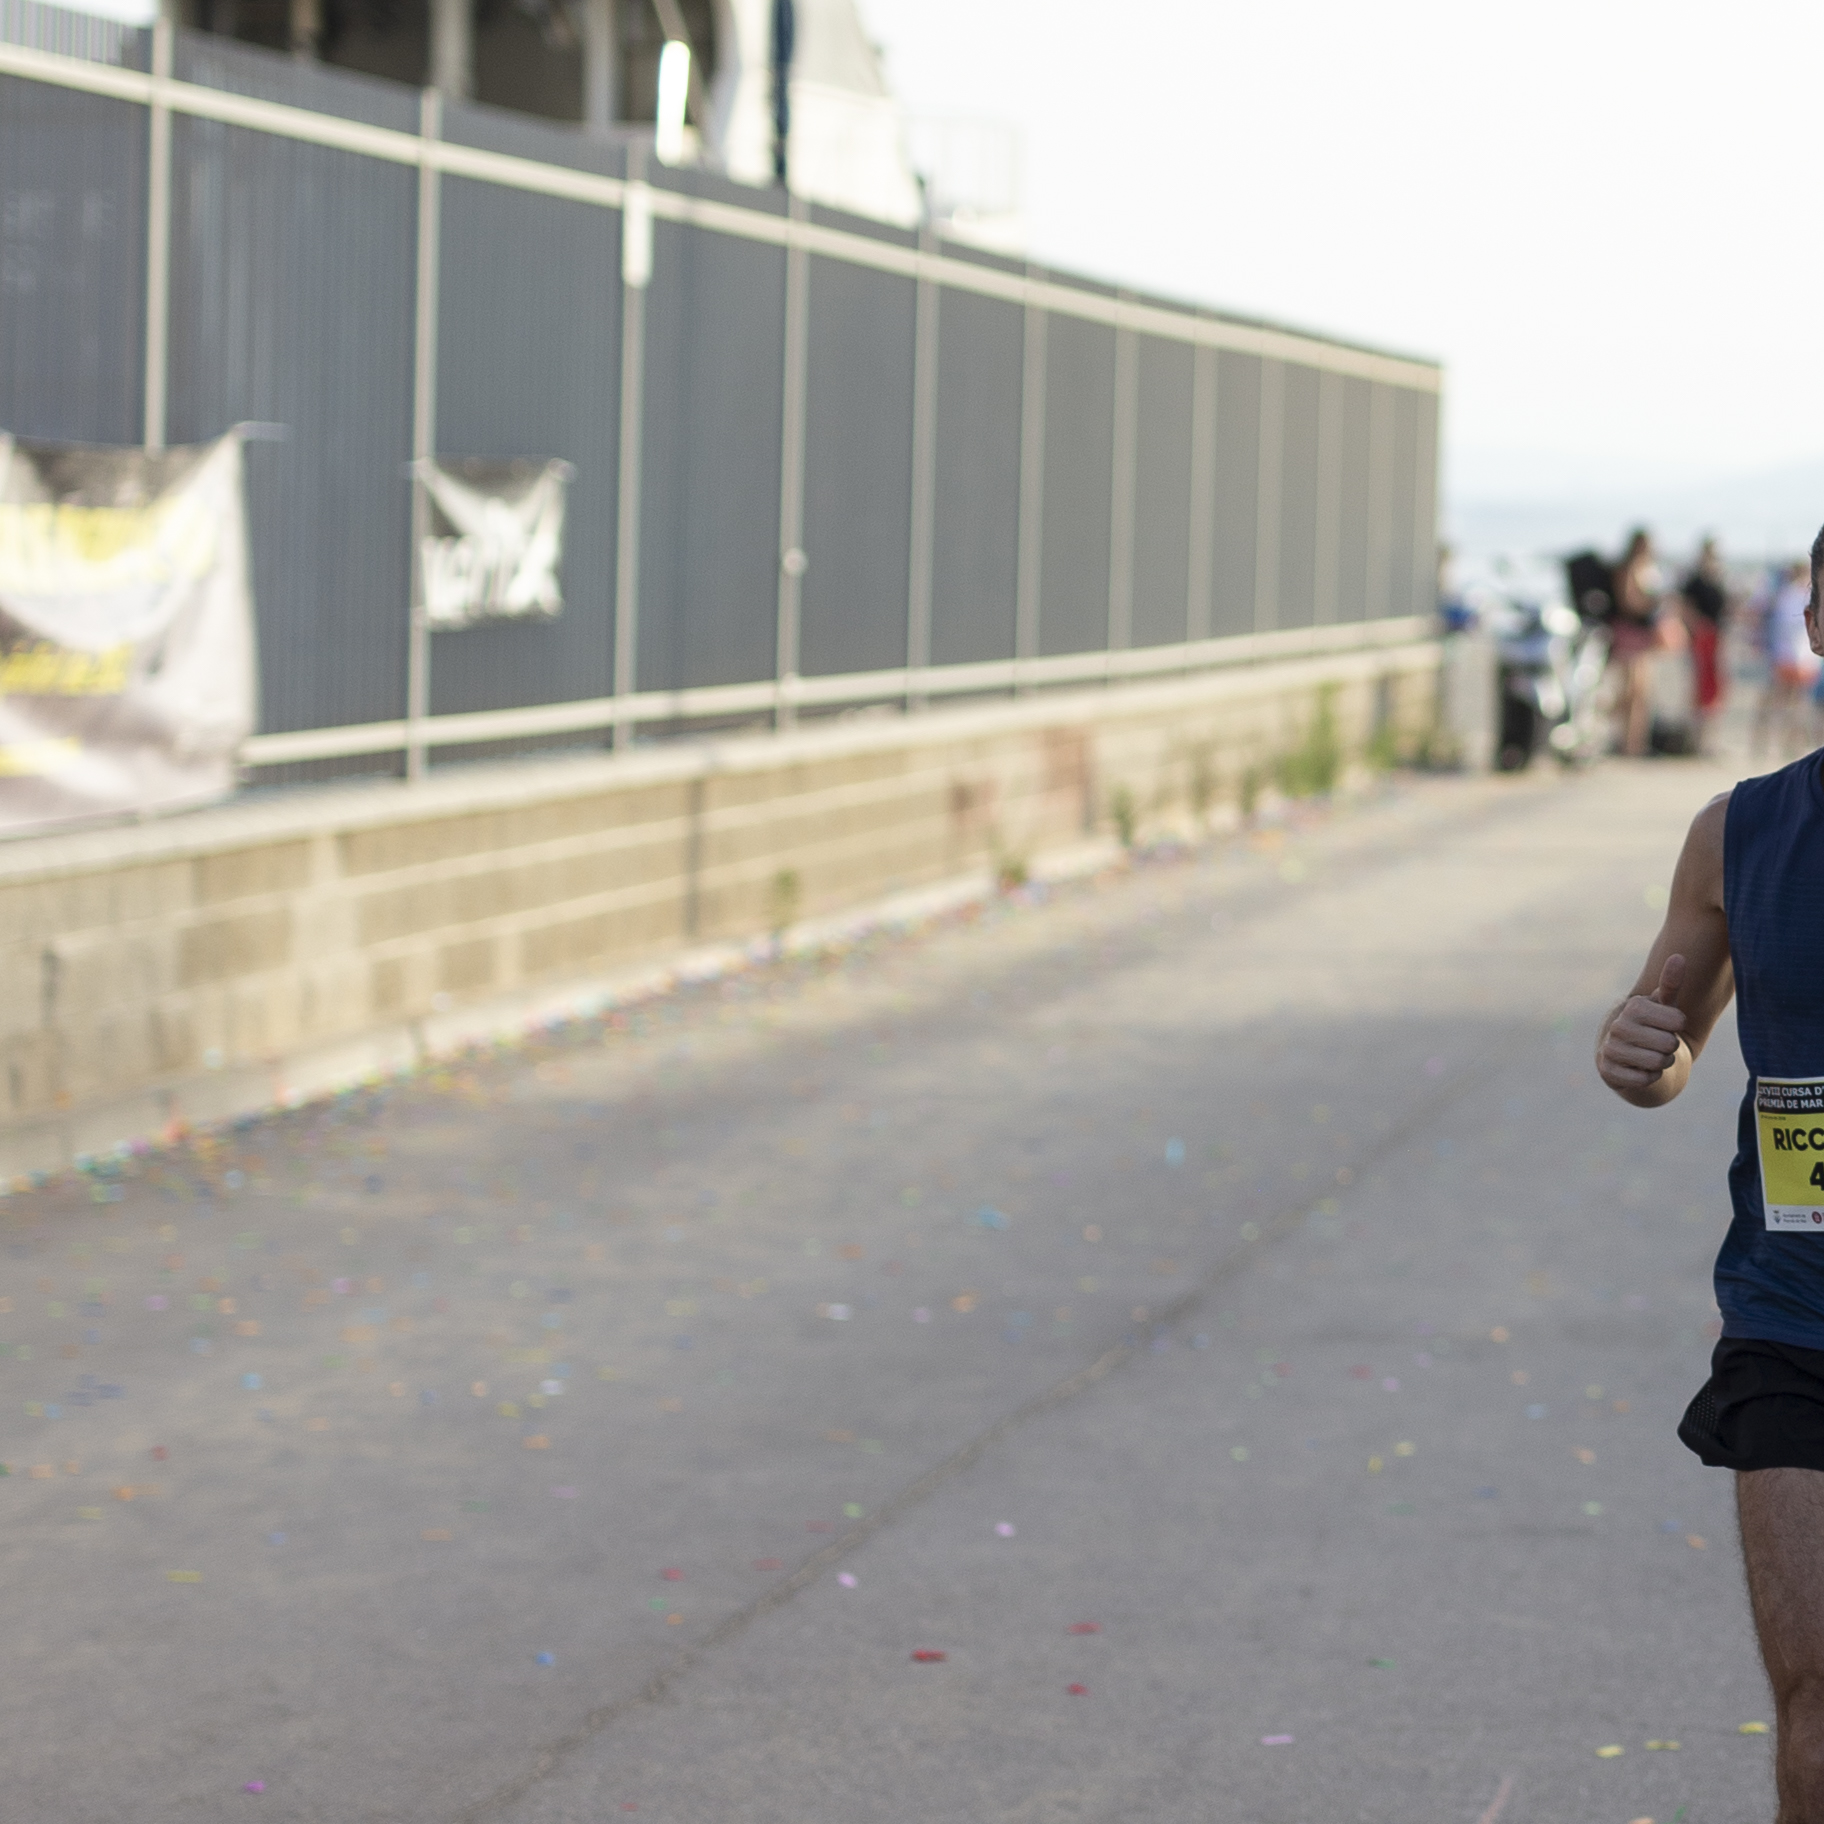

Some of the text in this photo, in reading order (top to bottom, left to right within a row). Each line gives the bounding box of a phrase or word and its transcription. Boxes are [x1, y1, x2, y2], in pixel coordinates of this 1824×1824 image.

[1782, 1086, 1812, 1097] CURSA
[1786, 1099, 1799, 1109] DE
[1800, 1098, 1824, 1109] MAR
